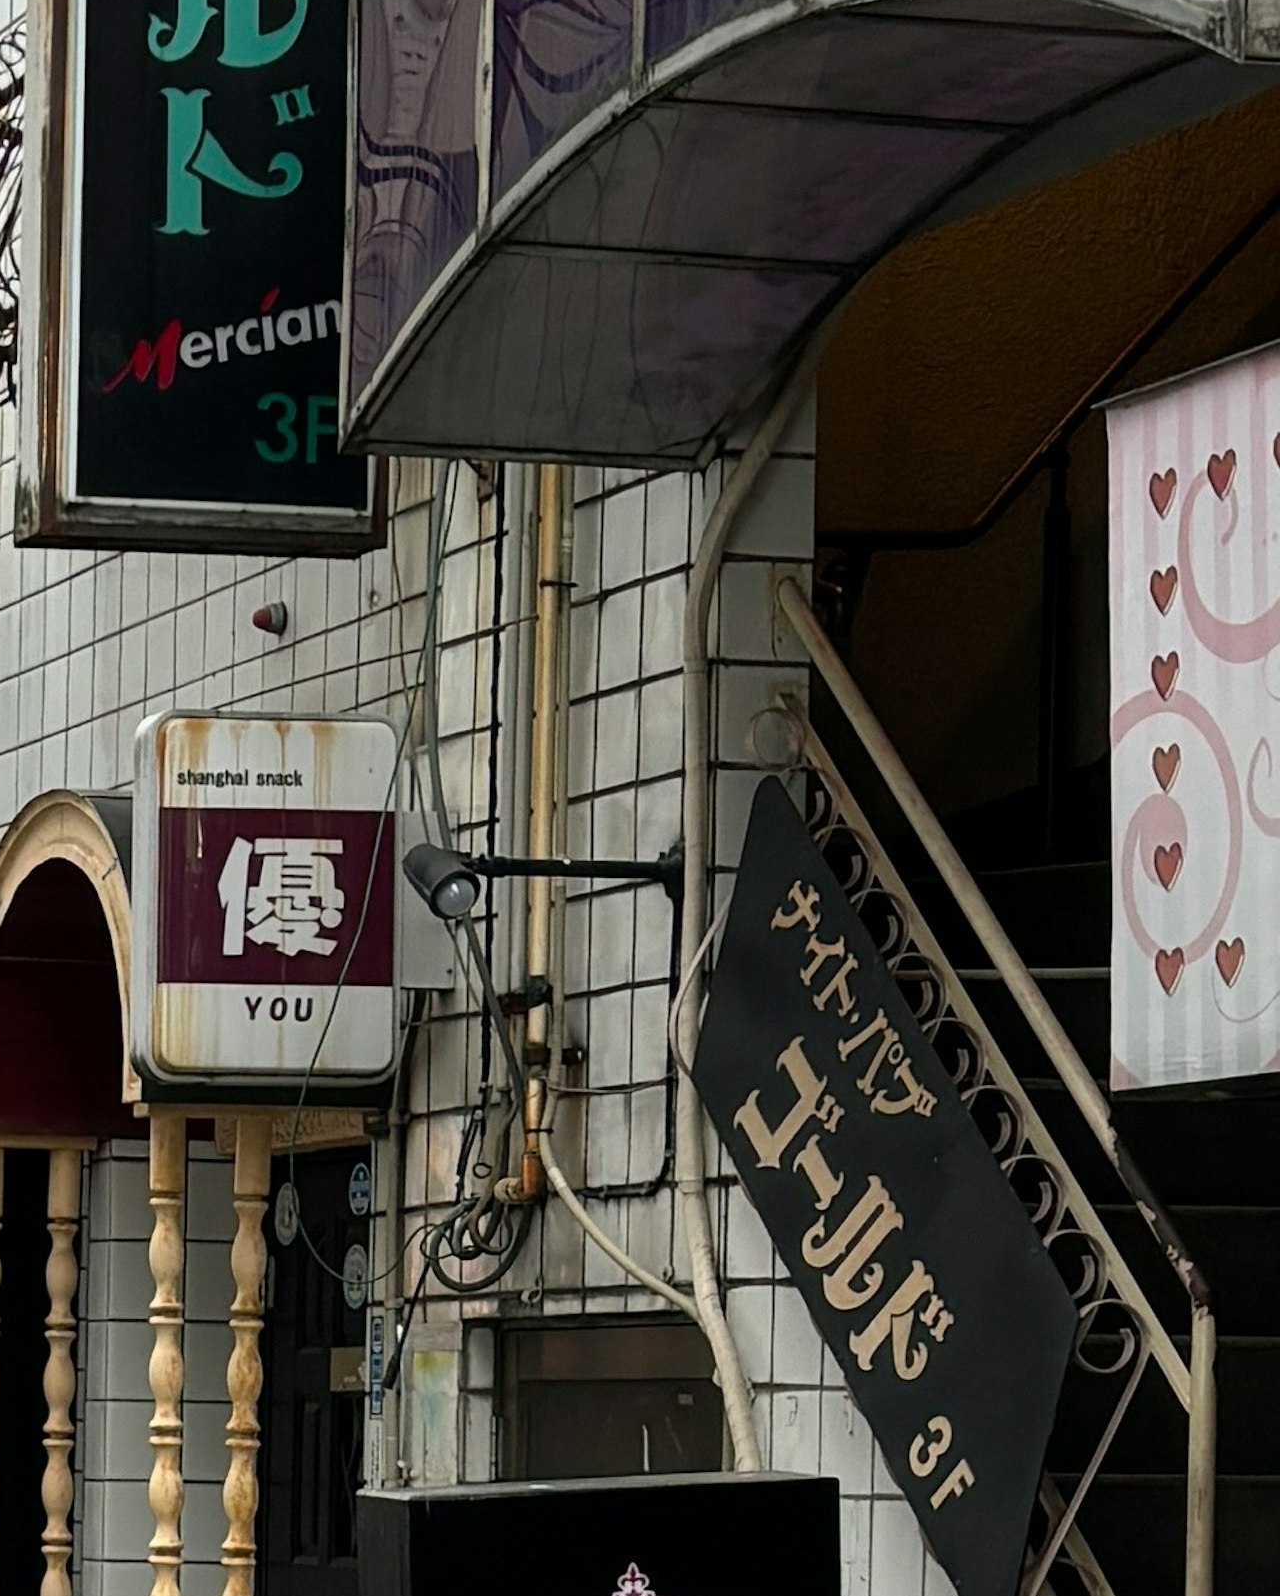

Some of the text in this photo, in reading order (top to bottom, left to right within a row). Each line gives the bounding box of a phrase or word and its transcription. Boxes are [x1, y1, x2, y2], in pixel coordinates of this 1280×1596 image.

[101, 286, 342, 393] Mercian
[254, 392, 338, 464] 3F
[256, 770, 303, 787] snack
[217, 836, 345, 957] 優
[244, 996, 314, 1022] YOU
[733, 1034, 956, 1382] ゴールド
[908, 1414, 975, 1511] 3F
